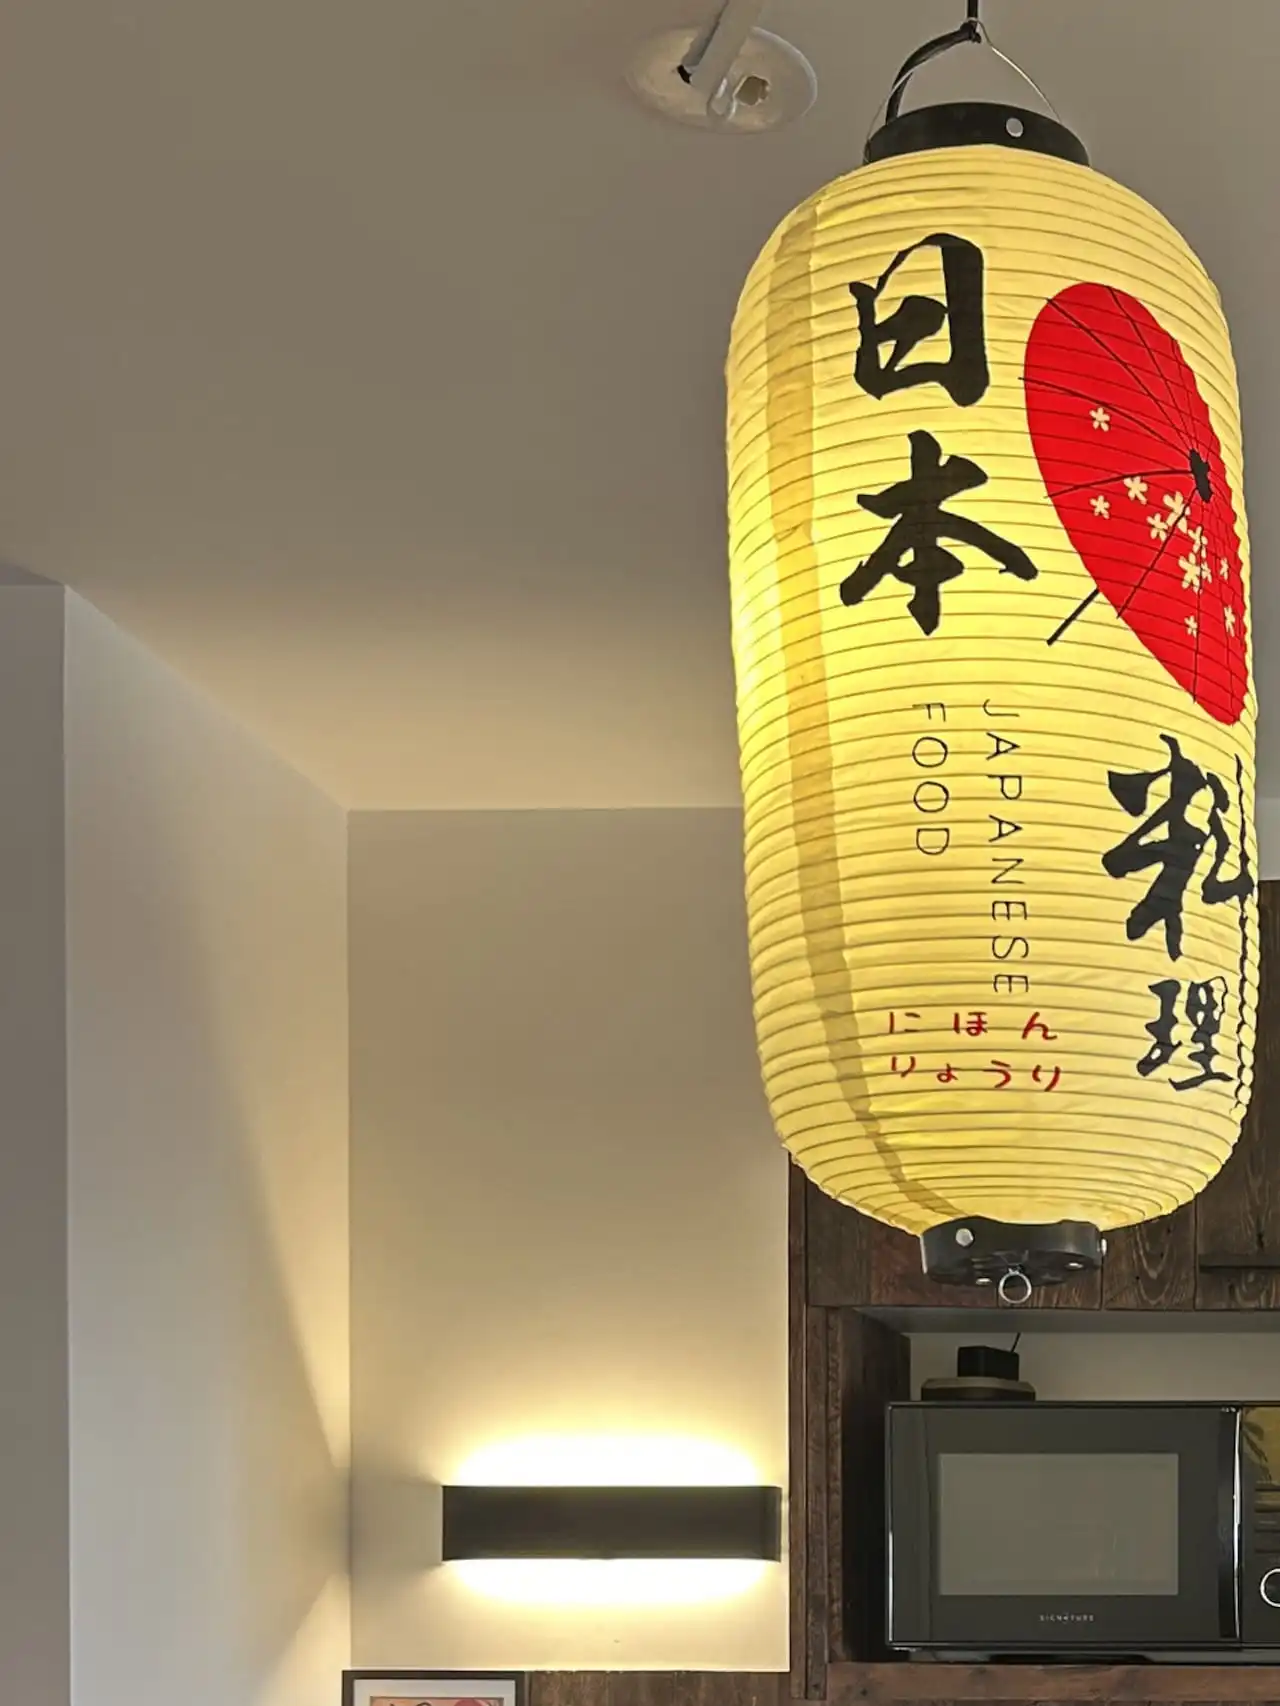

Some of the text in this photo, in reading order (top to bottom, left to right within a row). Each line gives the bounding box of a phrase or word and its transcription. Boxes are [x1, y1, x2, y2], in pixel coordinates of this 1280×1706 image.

[840, 232, 1038, 637] 日本
[911, 703, 950, 856] FOOD
[982, 699, 1029, 995] JAPANESE
